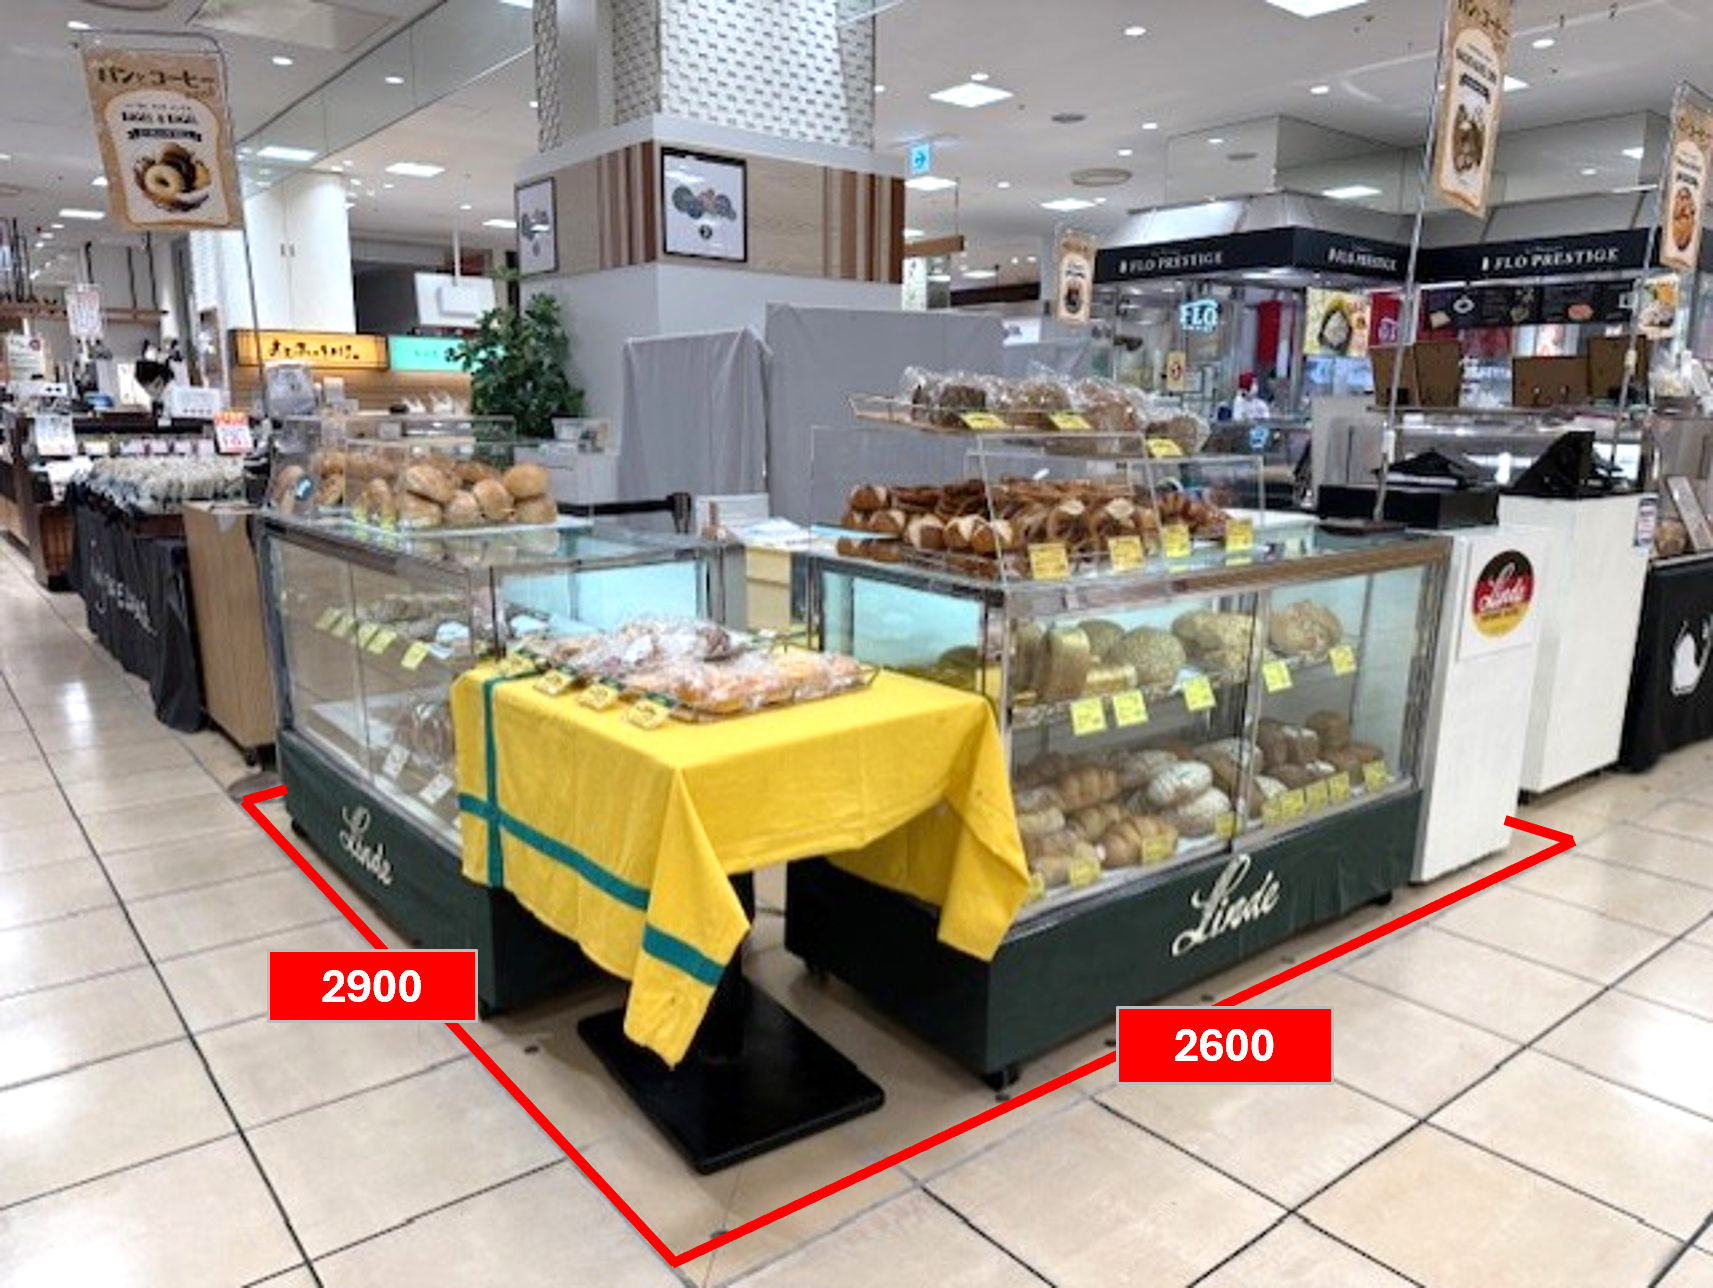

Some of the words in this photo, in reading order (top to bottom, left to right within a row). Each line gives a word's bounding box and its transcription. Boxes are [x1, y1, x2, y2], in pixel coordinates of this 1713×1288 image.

[1129, 258, 1155, 273] FLO
[1158, 252, 1222, 270] PRESTIGE
[1494, 255, 1527, 270] FLO
[1531, 247, 1619, 267] PRESTIGE
[1179, 302, 1219, 326] FLO
[340, 806, 393, 886] Linde
[1172, 853, 1281, 957] Linde
